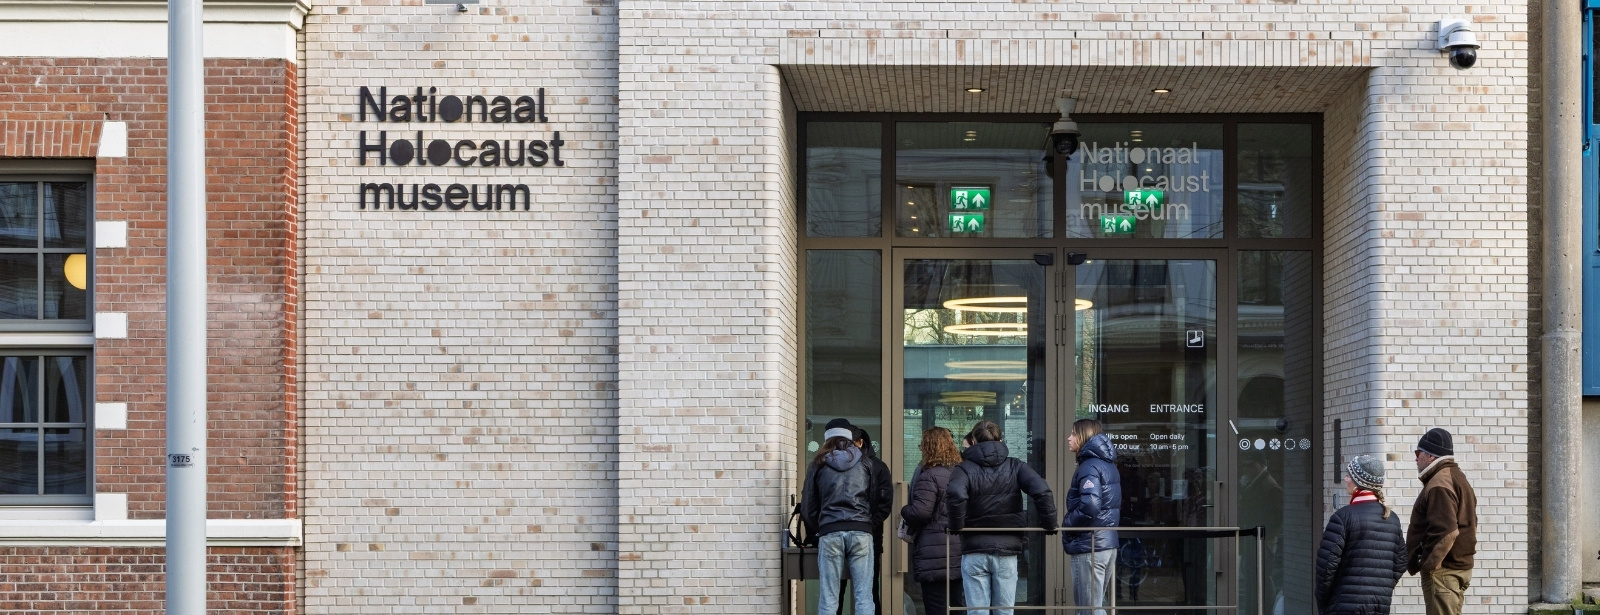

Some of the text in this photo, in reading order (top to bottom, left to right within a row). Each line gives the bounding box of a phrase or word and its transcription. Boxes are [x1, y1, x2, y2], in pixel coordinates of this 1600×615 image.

[360, 86, 548, 123] Nationaal
[360, 130, 565, 167] Holocaust
[1080, 141, 1199, 164] Nationaal
[1080, 169, 1210, 192] Holocaust
[360, 182, 530, 211] museum
[1080, 202, 1188, 220] museum
[1088, 404, 1129, 413] INGANG
[1150, 404, 1204, 413] ENTRANCE
